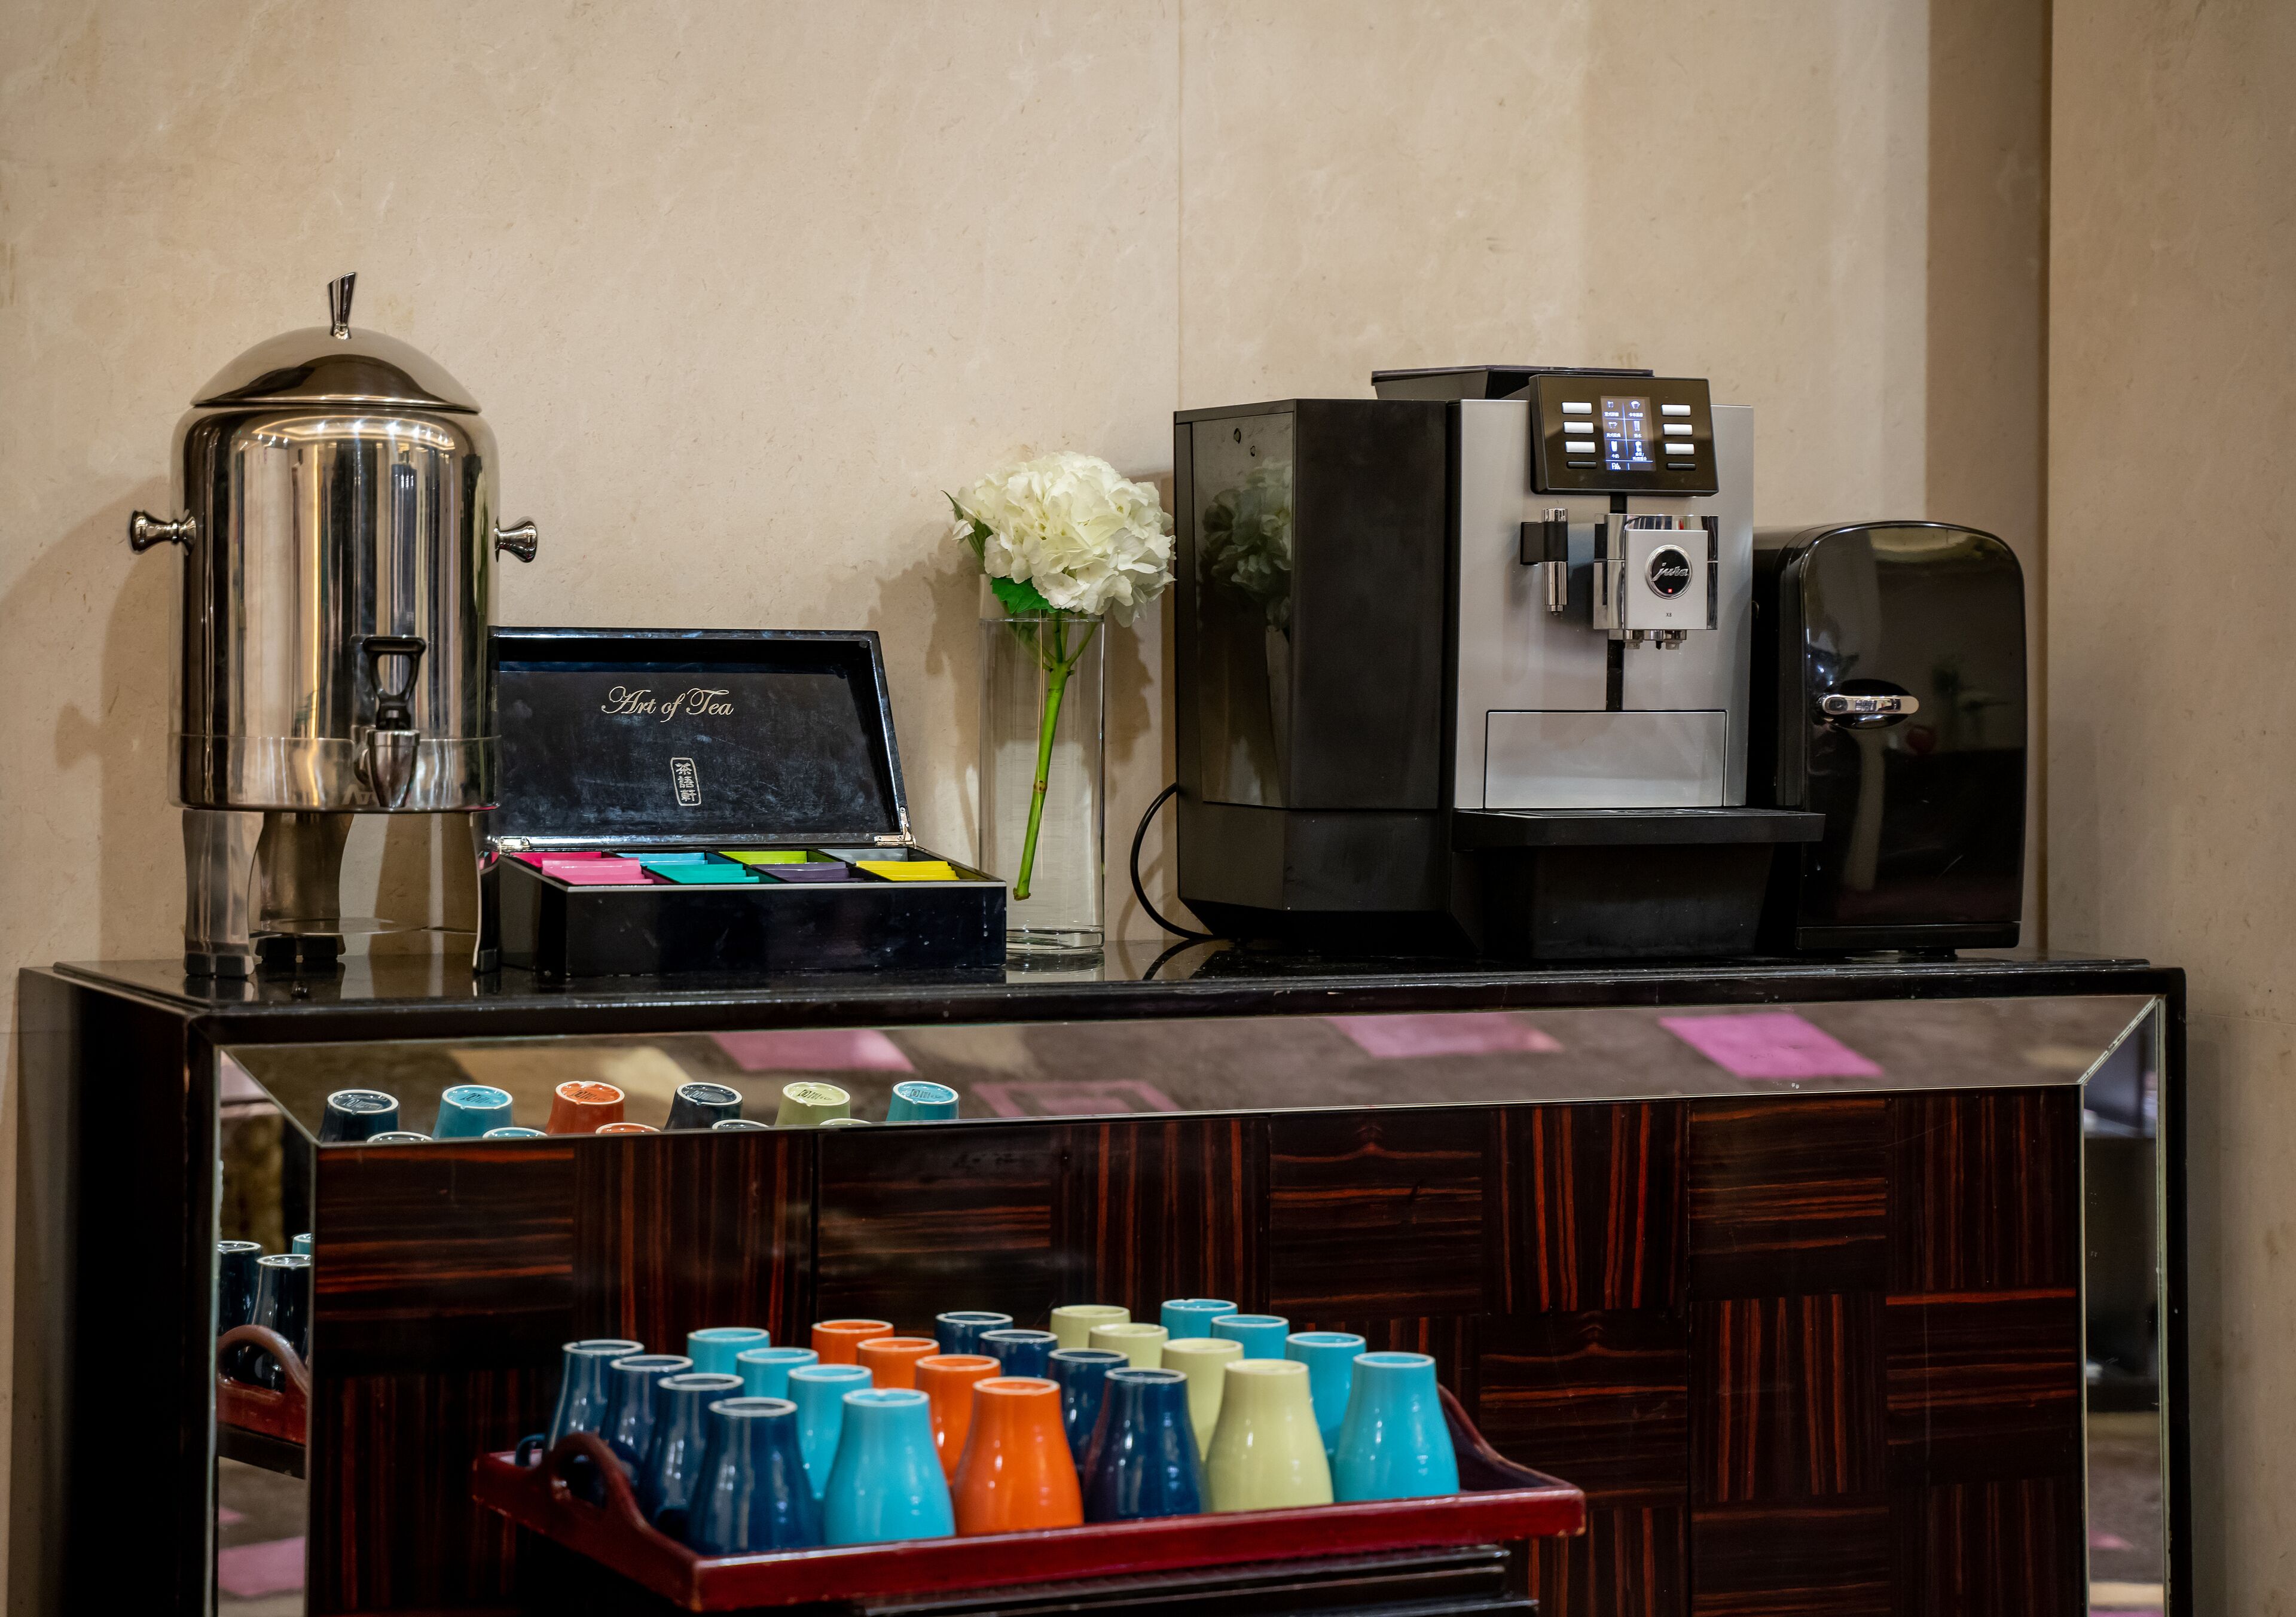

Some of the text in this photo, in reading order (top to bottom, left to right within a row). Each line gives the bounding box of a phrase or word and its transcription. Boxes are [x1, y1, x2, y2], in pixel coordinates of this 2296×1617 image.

[1651, 562, 1689, 582] jura
[601, 686, 734, 723] Art of Tea
[674, 762, 698, 802] 茶語軒
